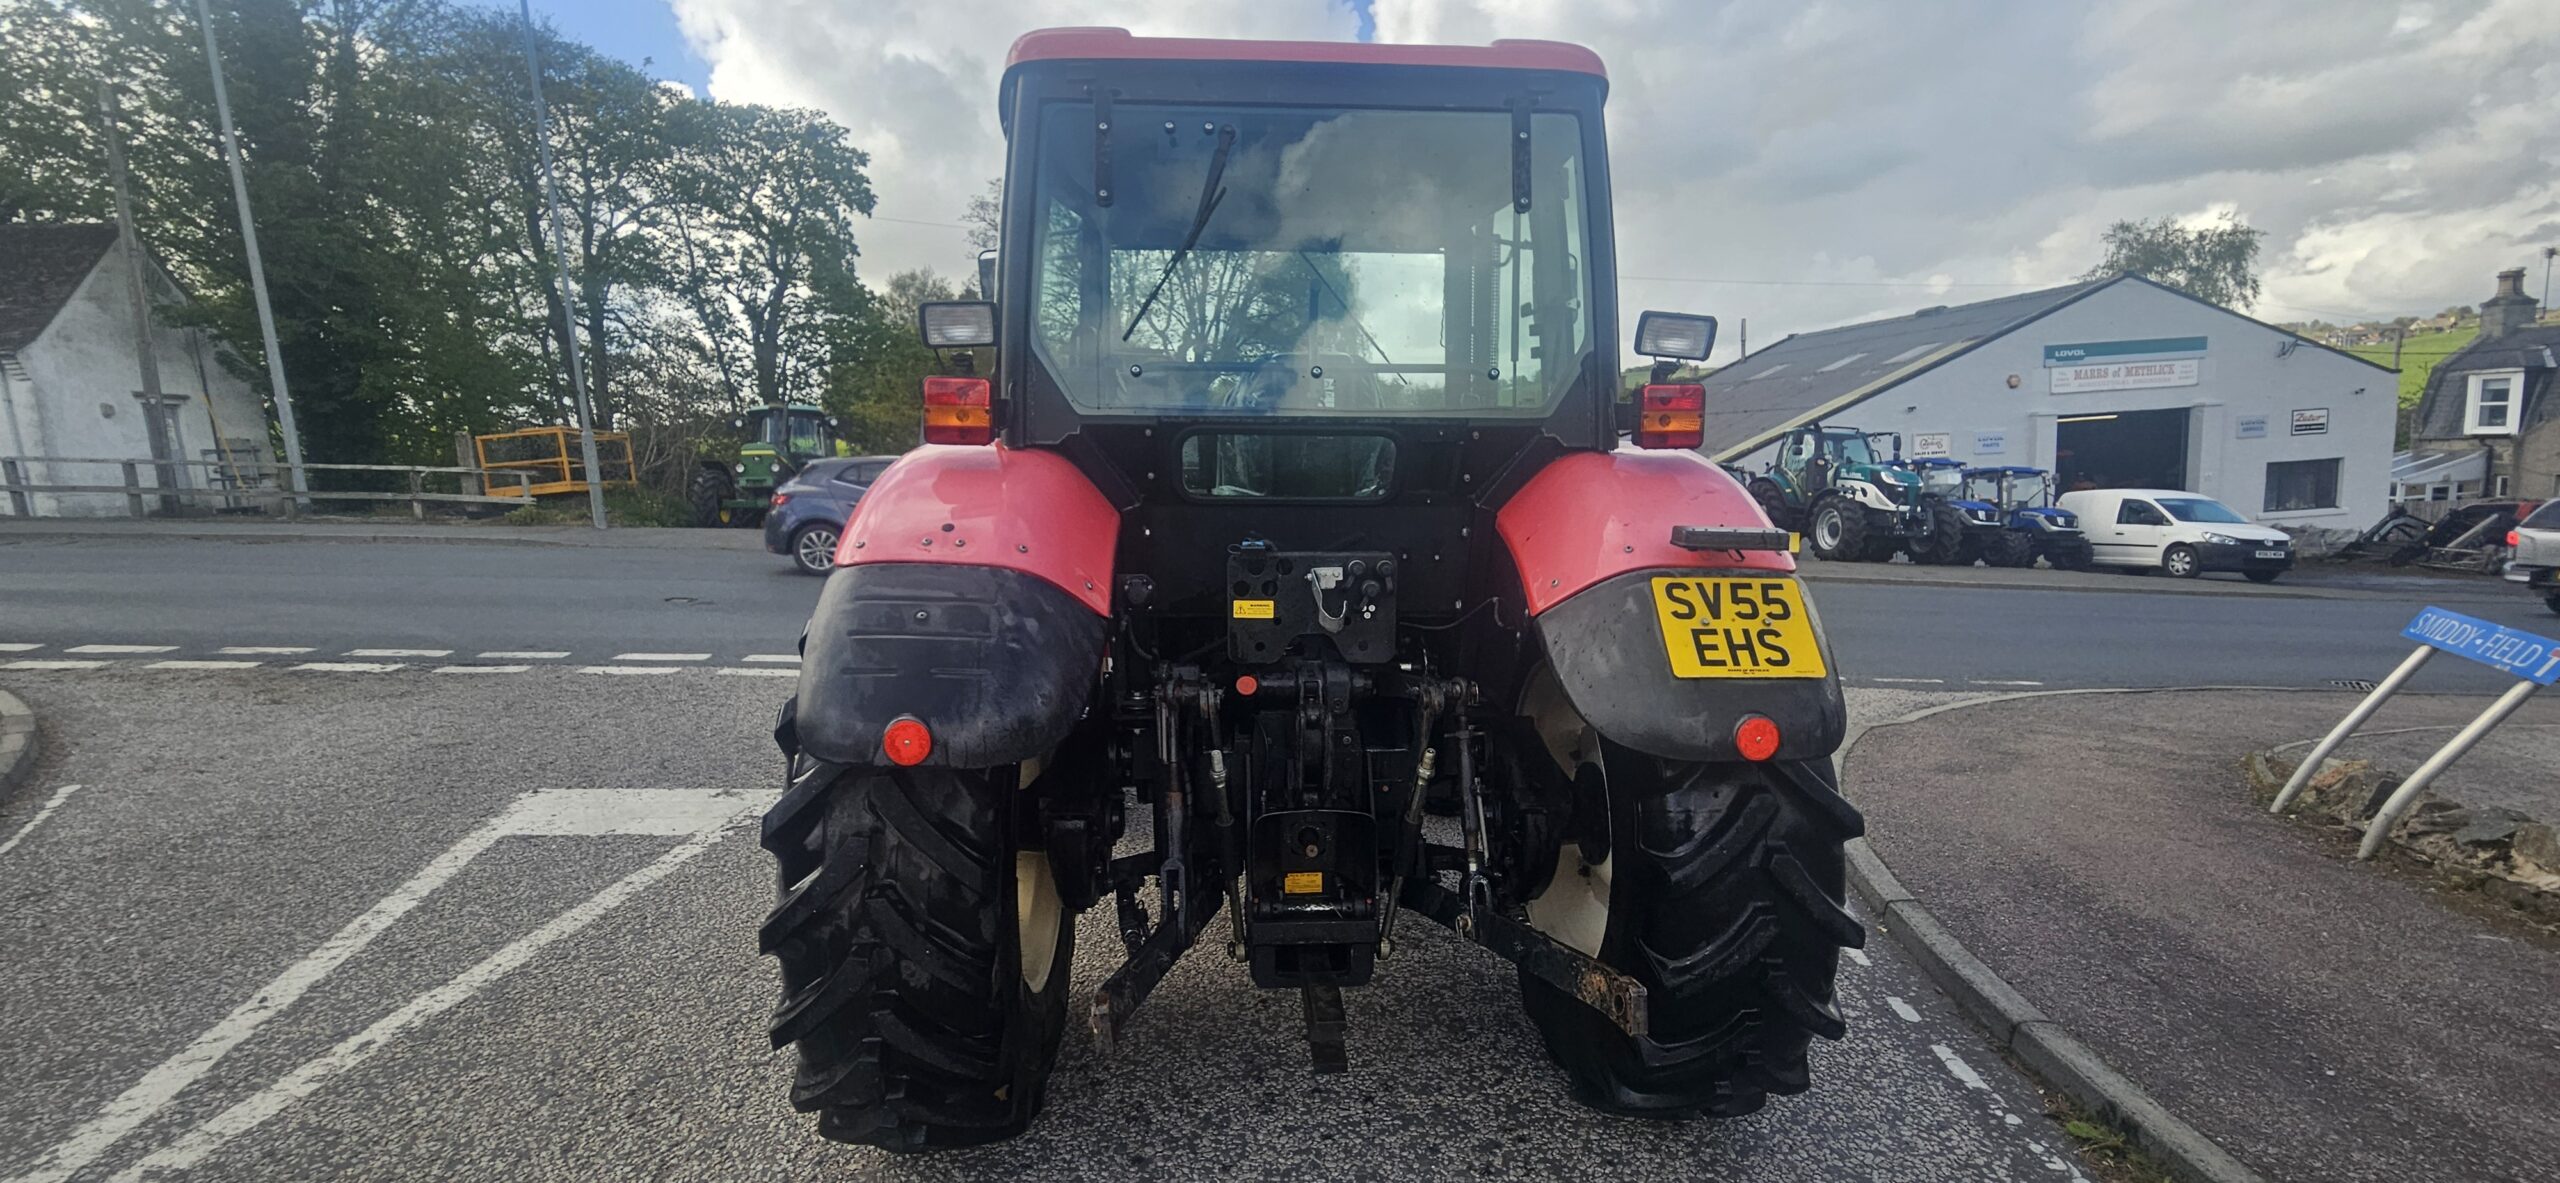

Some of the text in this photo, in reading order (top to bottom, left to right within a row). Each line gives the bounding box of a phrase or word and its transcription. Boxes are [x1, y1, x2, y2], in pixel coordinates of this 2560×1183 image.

[2055, 349, 2086, 357] LOVOL
[2112, 366, 2121, 378] of
[2125, 363, 2176, 377] METHLICK
[1665, 582, 1792, 621] SV55
[1690, 628, 1791, 667] EHS
[2410, 613, 2543, 668] SMIDDY FIELD
